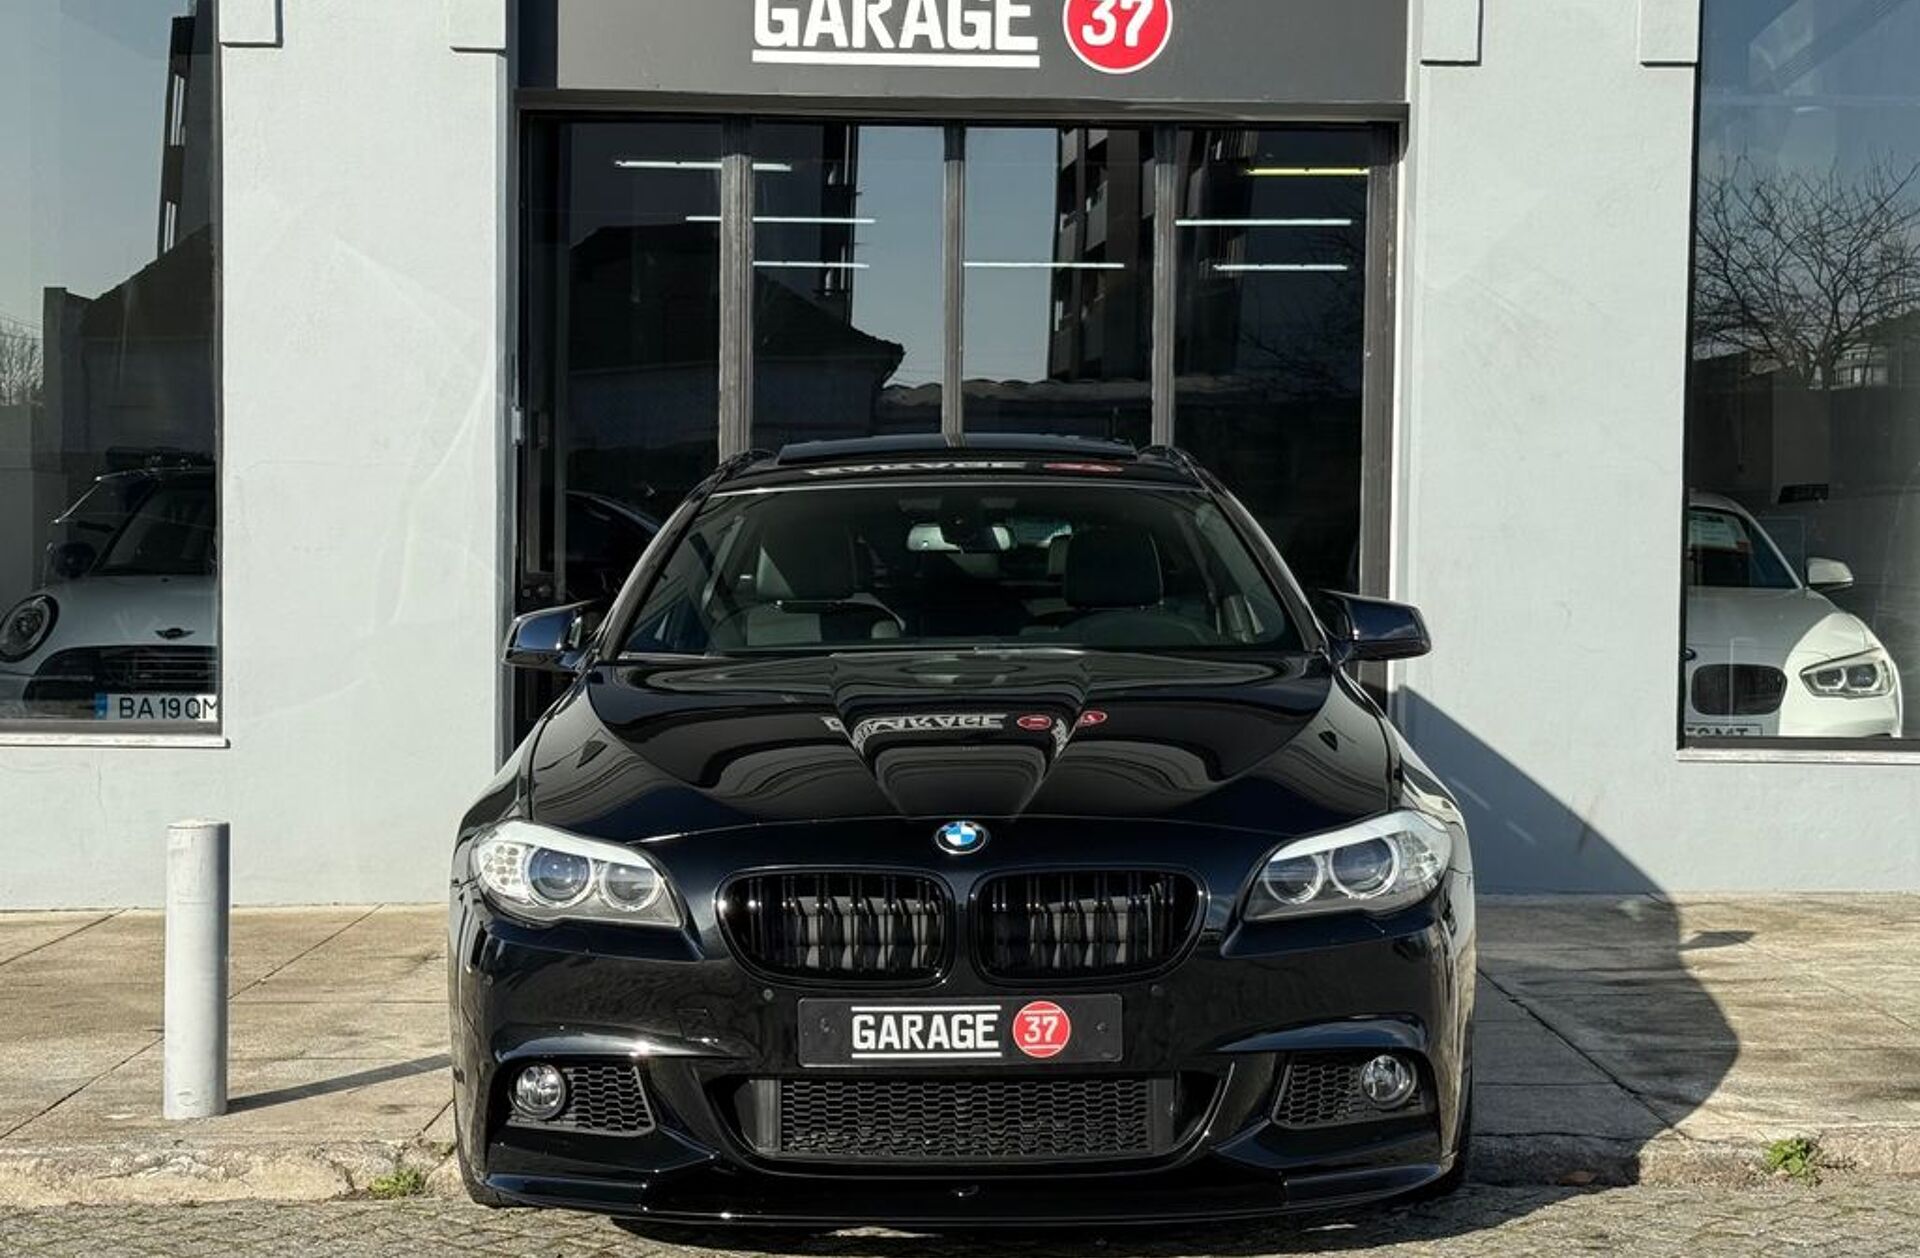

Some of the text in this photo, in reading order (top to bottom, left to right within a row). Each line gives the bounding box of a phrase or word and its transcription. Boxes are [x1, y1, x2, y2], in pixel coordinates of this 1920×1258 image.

[753, 0, 1154, 50] GARAGE 37
[119, 697, 154, 719] BA
[159, 697, 181, 719] 19
[851, 1014, 1058, 1049] GARAGE 37
